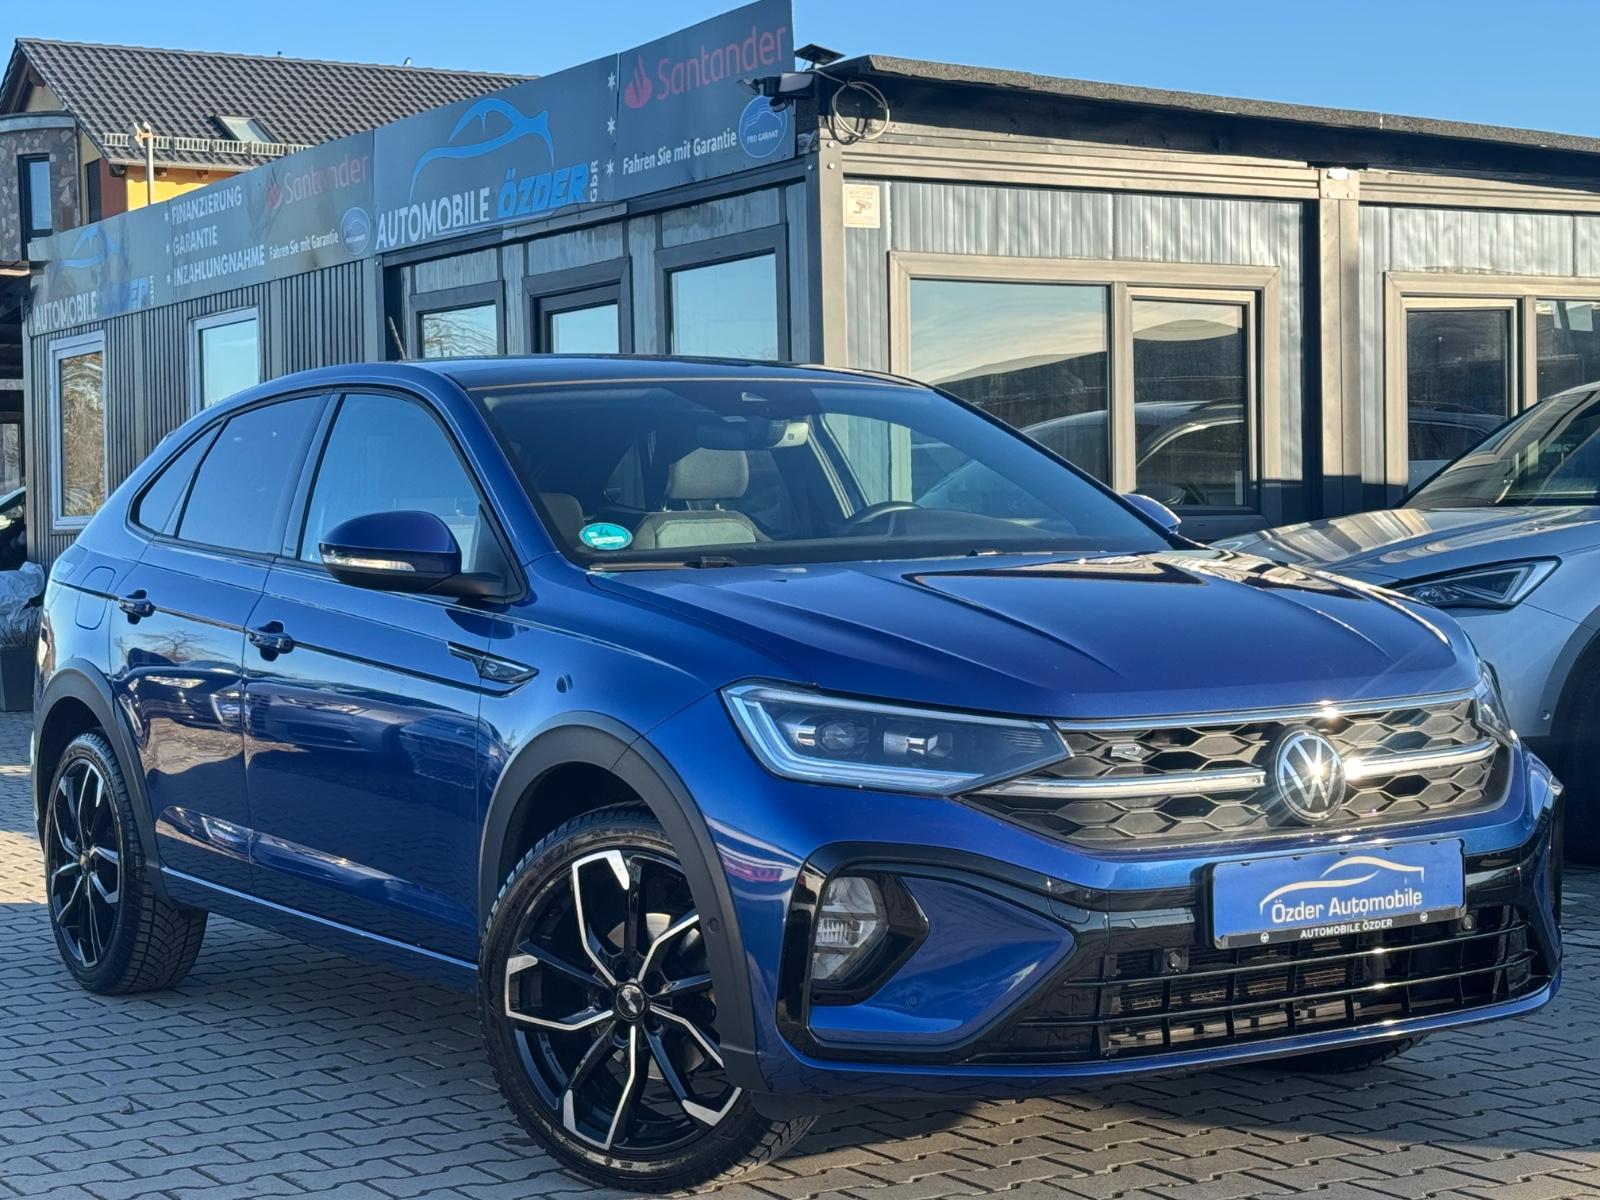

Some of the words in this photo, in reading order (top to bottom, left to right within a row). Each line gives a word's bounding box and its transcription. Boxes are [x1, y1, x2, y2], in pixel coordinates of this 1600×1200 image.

[656, 26, 787, 101] Santander
[622, 152, 656, 176] Fahren
[657, 145, 672, 167] Sie
[673, 139, 691, 162] mit
[692, 127, 737, 157] Garantie
[171, 184, 242, 226] FINANZIERUNG
[374, 187, 491, 250] AUTOMOBILE
[497, 162, 589, 219] ÖZDER
[589, 160, 600, 203] GbR
[172, 224, 219, 257] GARANTIE
[269, 244, 290, 261] Fahren
[290, 239, 300, 256] Sie
[311, 227, 339, 250] Garantie
[173, 243, 266, 288] INZAHLUNGNAHME
[33, 289, 98, 333] AUTOMOBILE
[1271, 899, 1324, 924] Özder
[1327, 887, 1423, 918] Automobile
[1299, 922, 1362, 940] AUTOMOBILE
[1362, 918, 1394, 933] ÖZDER
